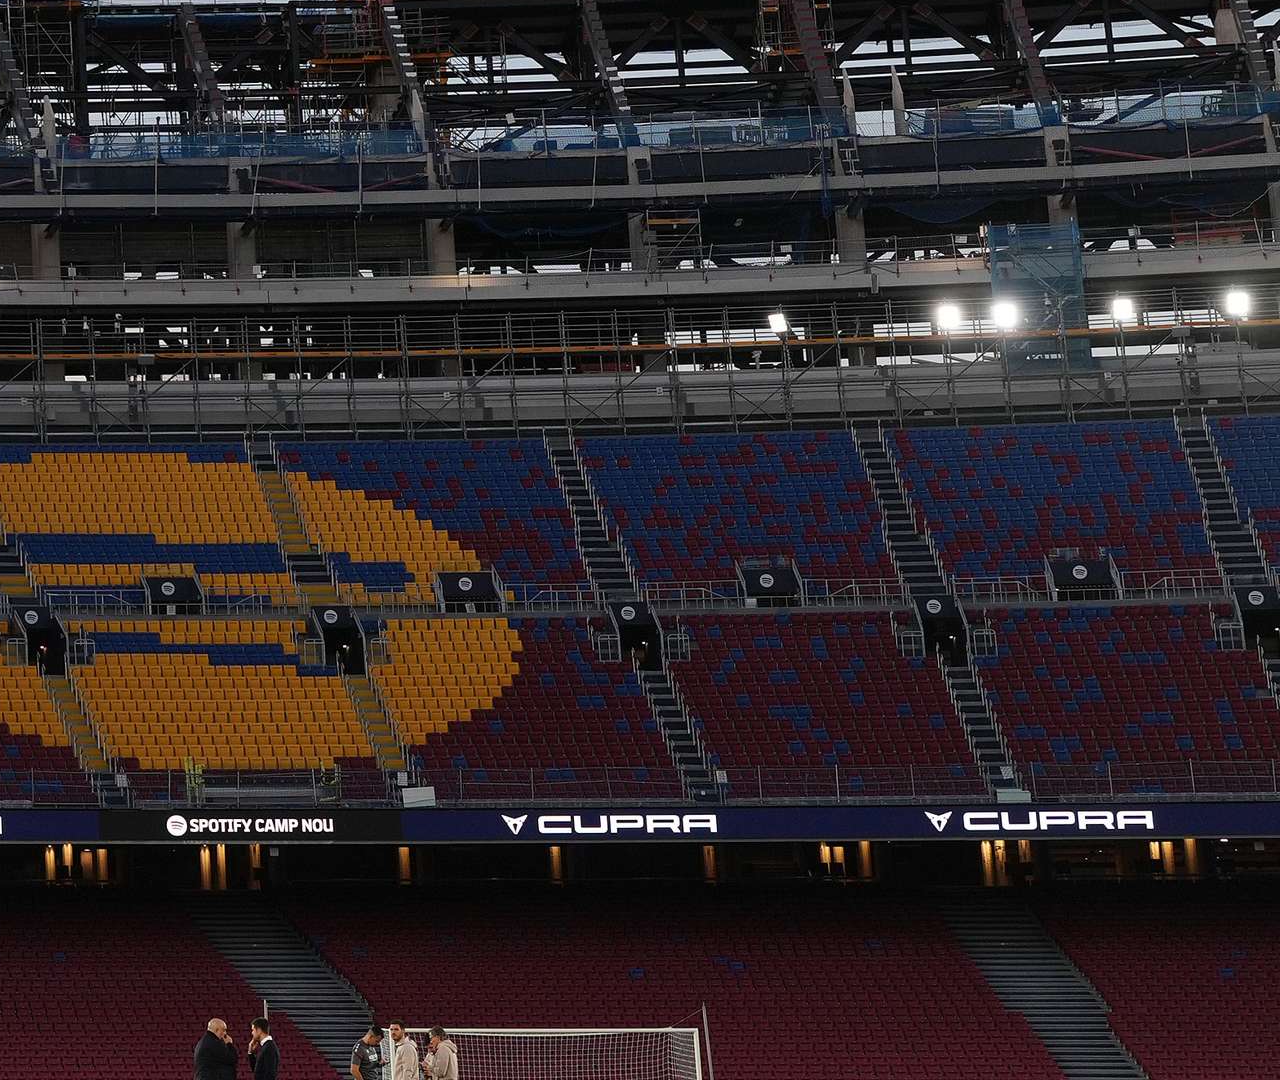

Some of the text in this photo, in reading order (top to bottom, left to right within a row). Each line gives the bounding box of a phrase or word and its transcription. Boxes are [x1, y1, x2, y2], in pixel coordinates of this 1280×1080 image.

[190, 818, 334, 833] SPOTIFY CAMP NOU
[537, 814, 718, 834] CUPRA
[962, 810, 1155, 831] CUPRA
